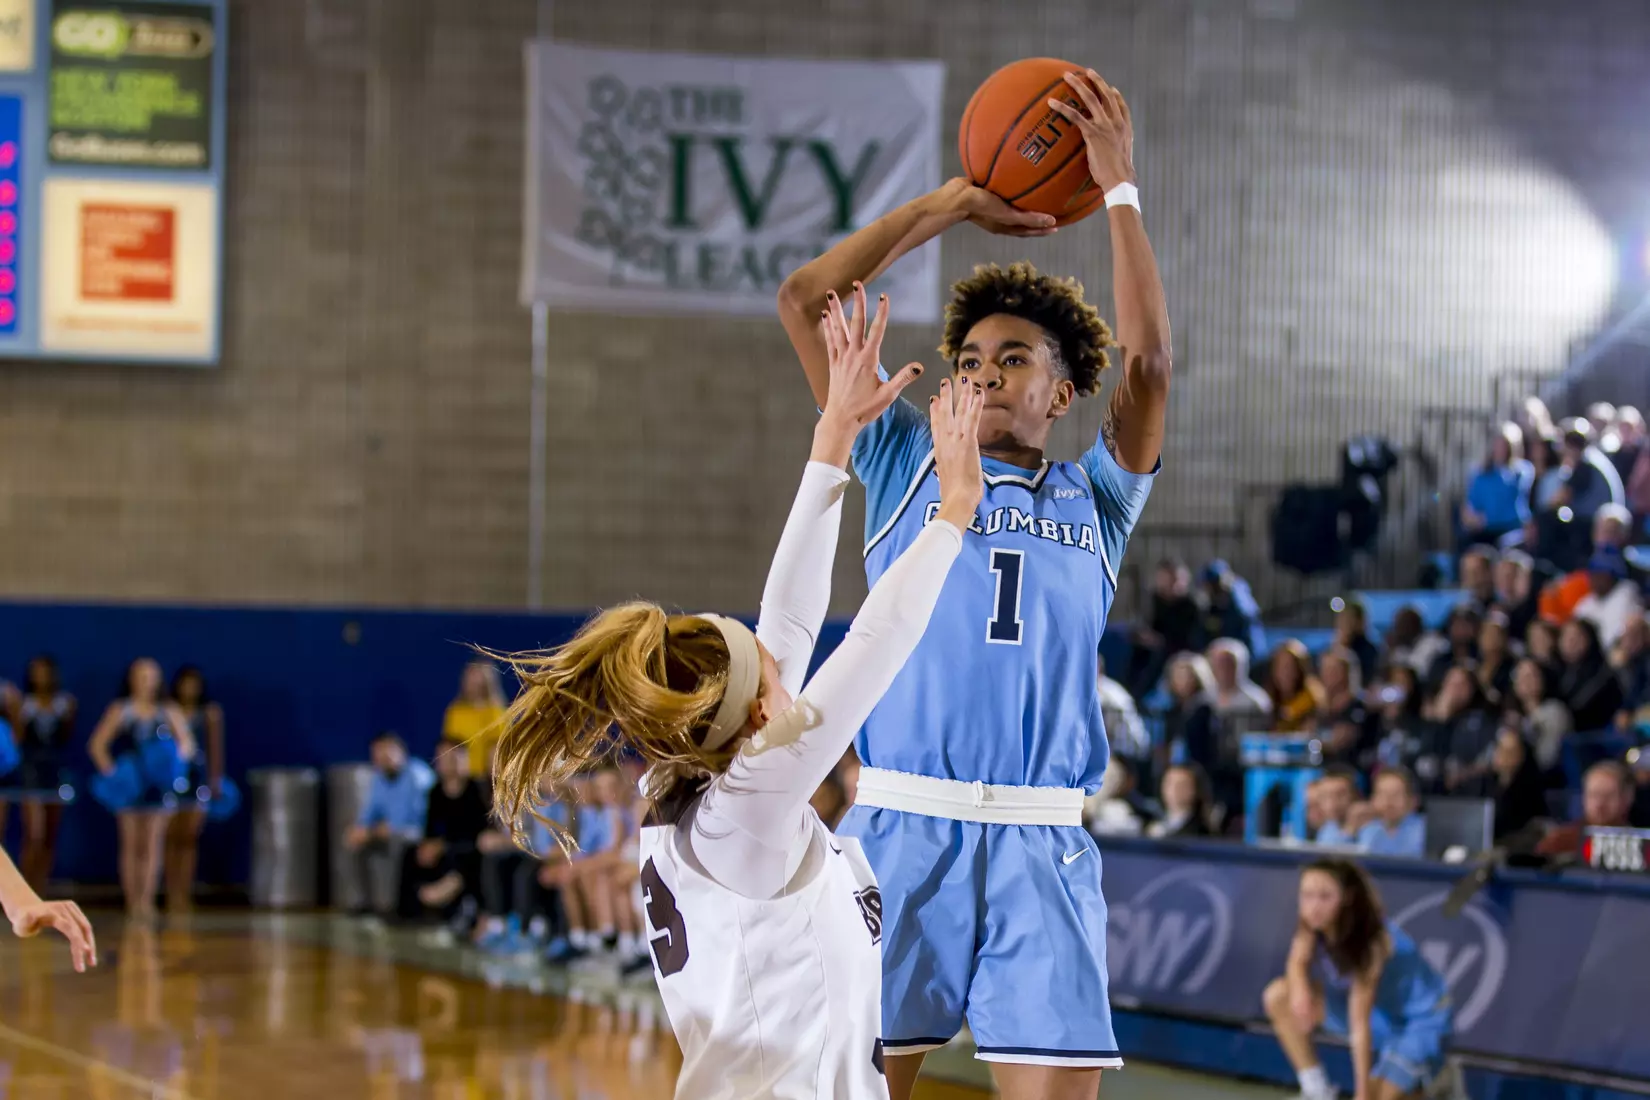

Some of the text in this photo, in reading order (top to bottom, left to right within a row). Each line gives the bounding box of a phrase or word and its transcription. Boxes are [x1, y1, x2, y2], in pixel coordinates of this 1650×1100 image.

[666, 84, 746, 123] THE
[666, 133, 880, 233] IVY
[923, 501, 1096, 556] CLUMBIA
[986, 547, 1024, 645] 1
[640, 855, 690, 979] 3
